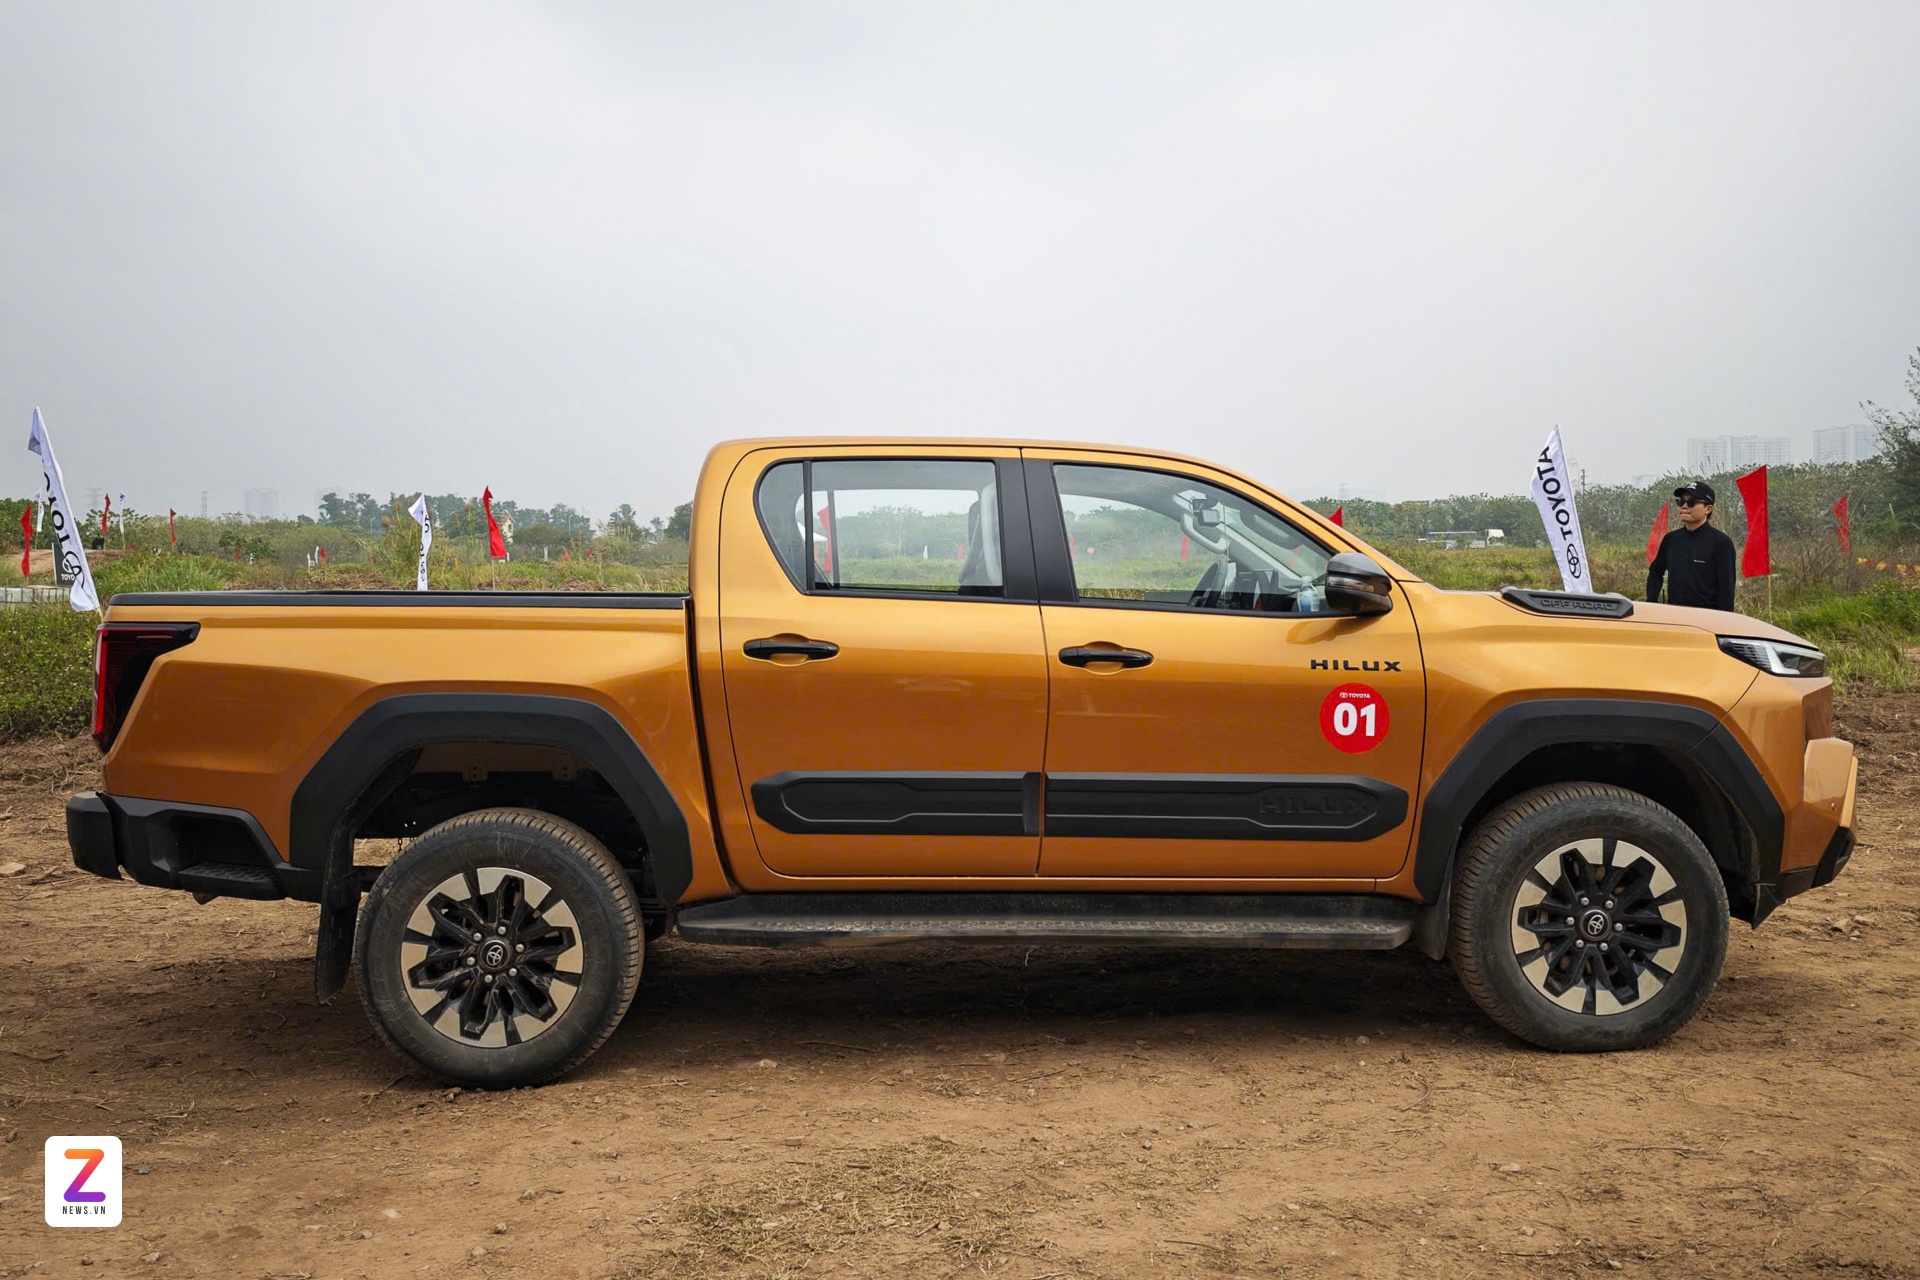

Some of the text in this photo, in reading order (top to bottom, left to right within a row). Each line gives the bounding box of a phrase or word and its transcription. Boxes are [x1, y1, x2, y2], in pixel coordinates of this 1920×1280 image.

[1537, 446, 1573, 541] TOYOTA
[1541, 599, 1616, 610] OFF ROAD
[1310, 659, 1401, 672] HILUX
[1333, 702, 1376, 737] 01
[1258, 796, 1369, 814] HILUX
